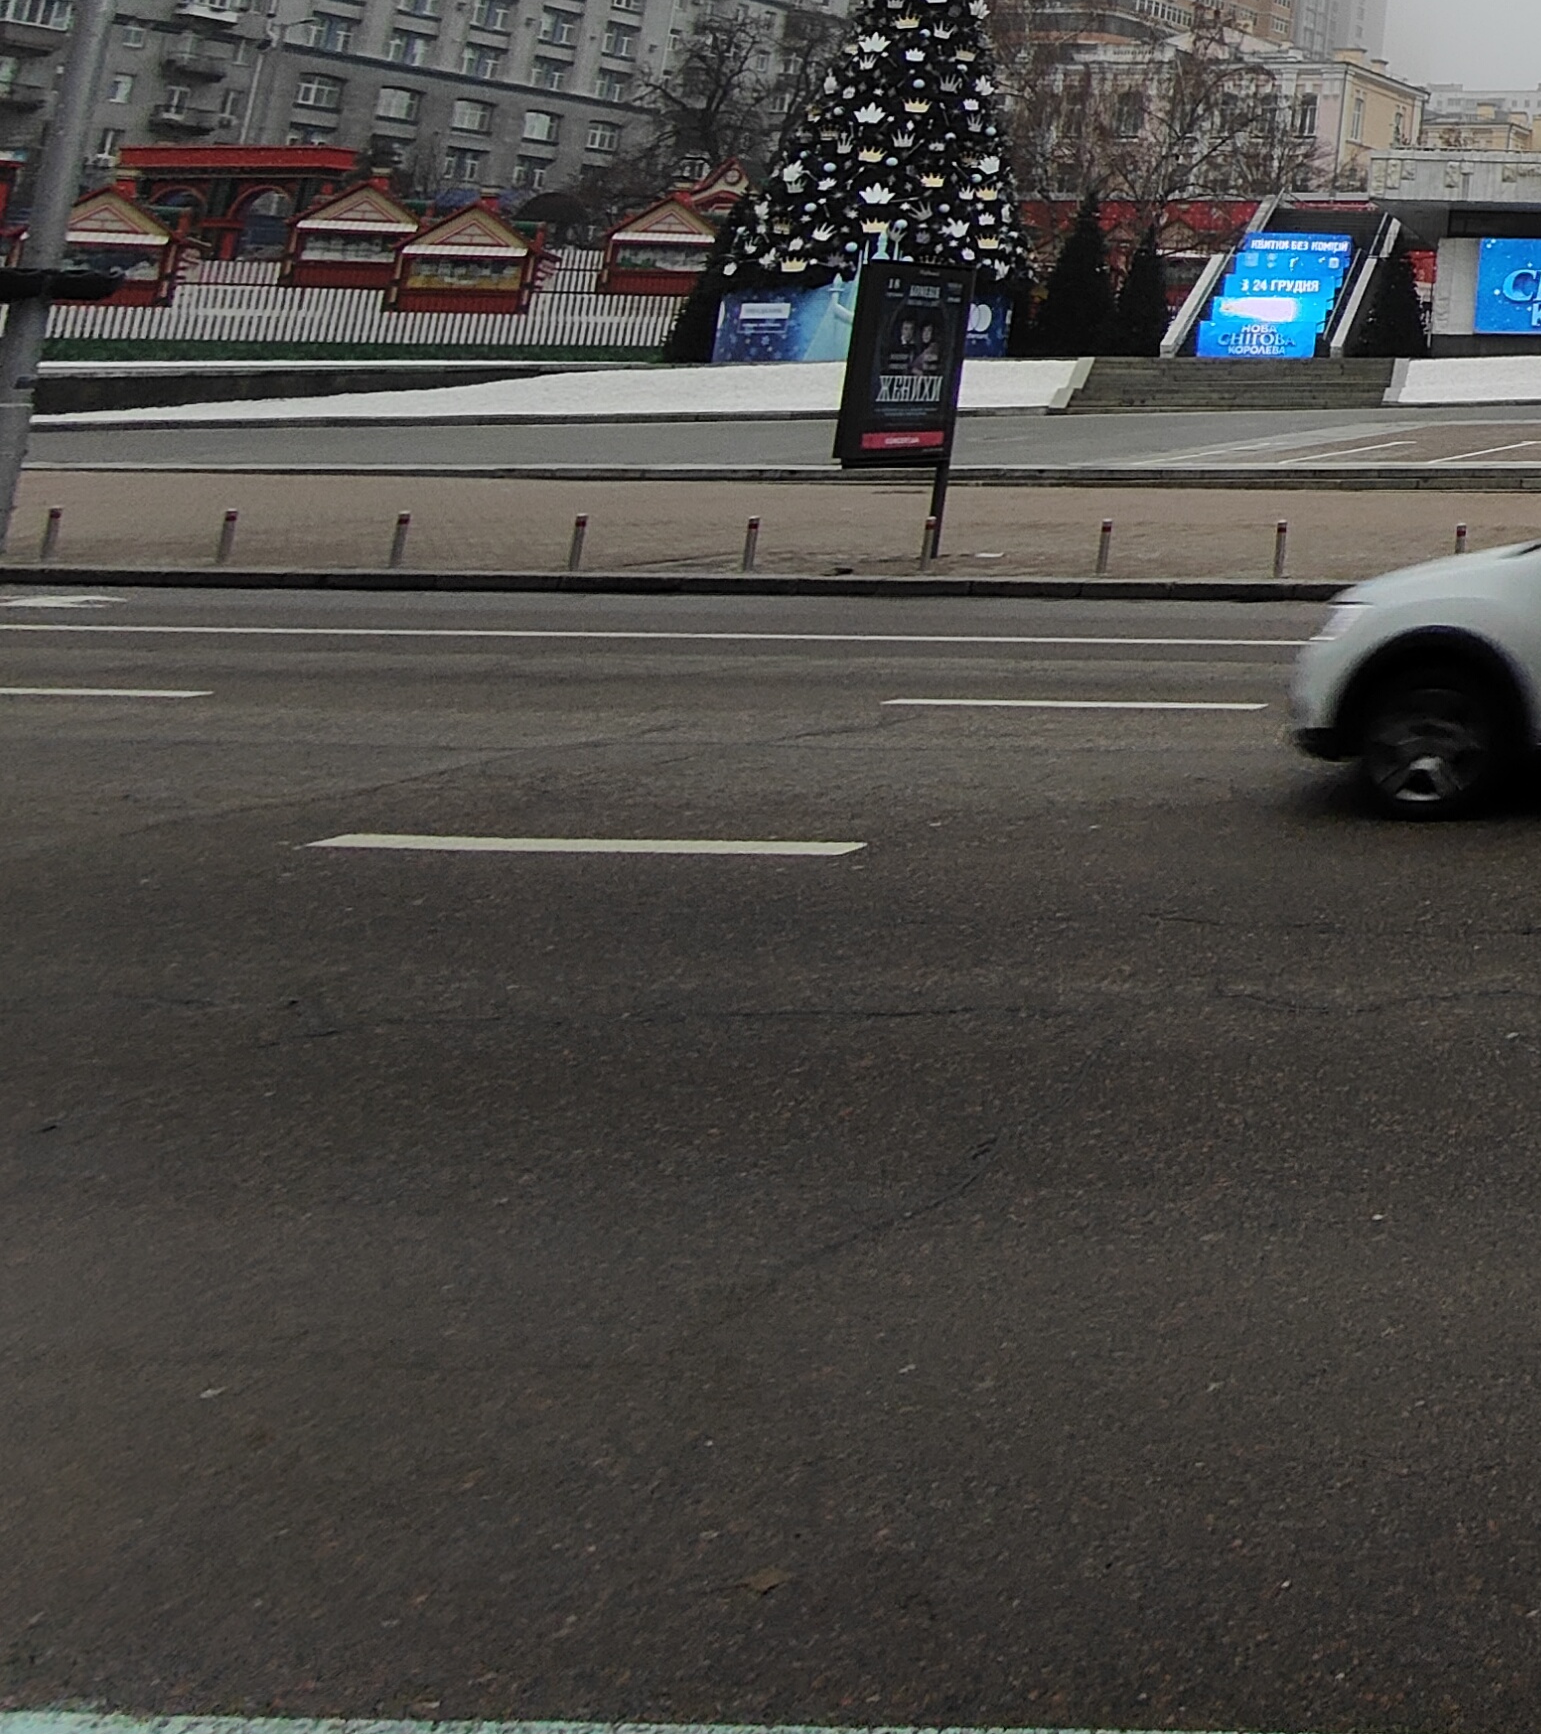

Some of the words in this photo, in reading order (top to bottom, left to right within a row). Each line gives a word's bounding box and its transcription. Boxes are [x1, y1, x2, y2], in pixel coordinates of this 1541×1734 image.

[1291, 240, 1309, 251] БЕЗ
[1253, 279, 1268, 291] 24
[1270, 280, 1319, 293] ГРУДНЯ
[1241, 324, 1278, 333] НОВА
[1217, 332, 1297, 346] СНІГОВА
[1228, 345, 1286, 355] КОРОЛЕВА
[875, 375, 943, 402] ЖЕНИХИ
